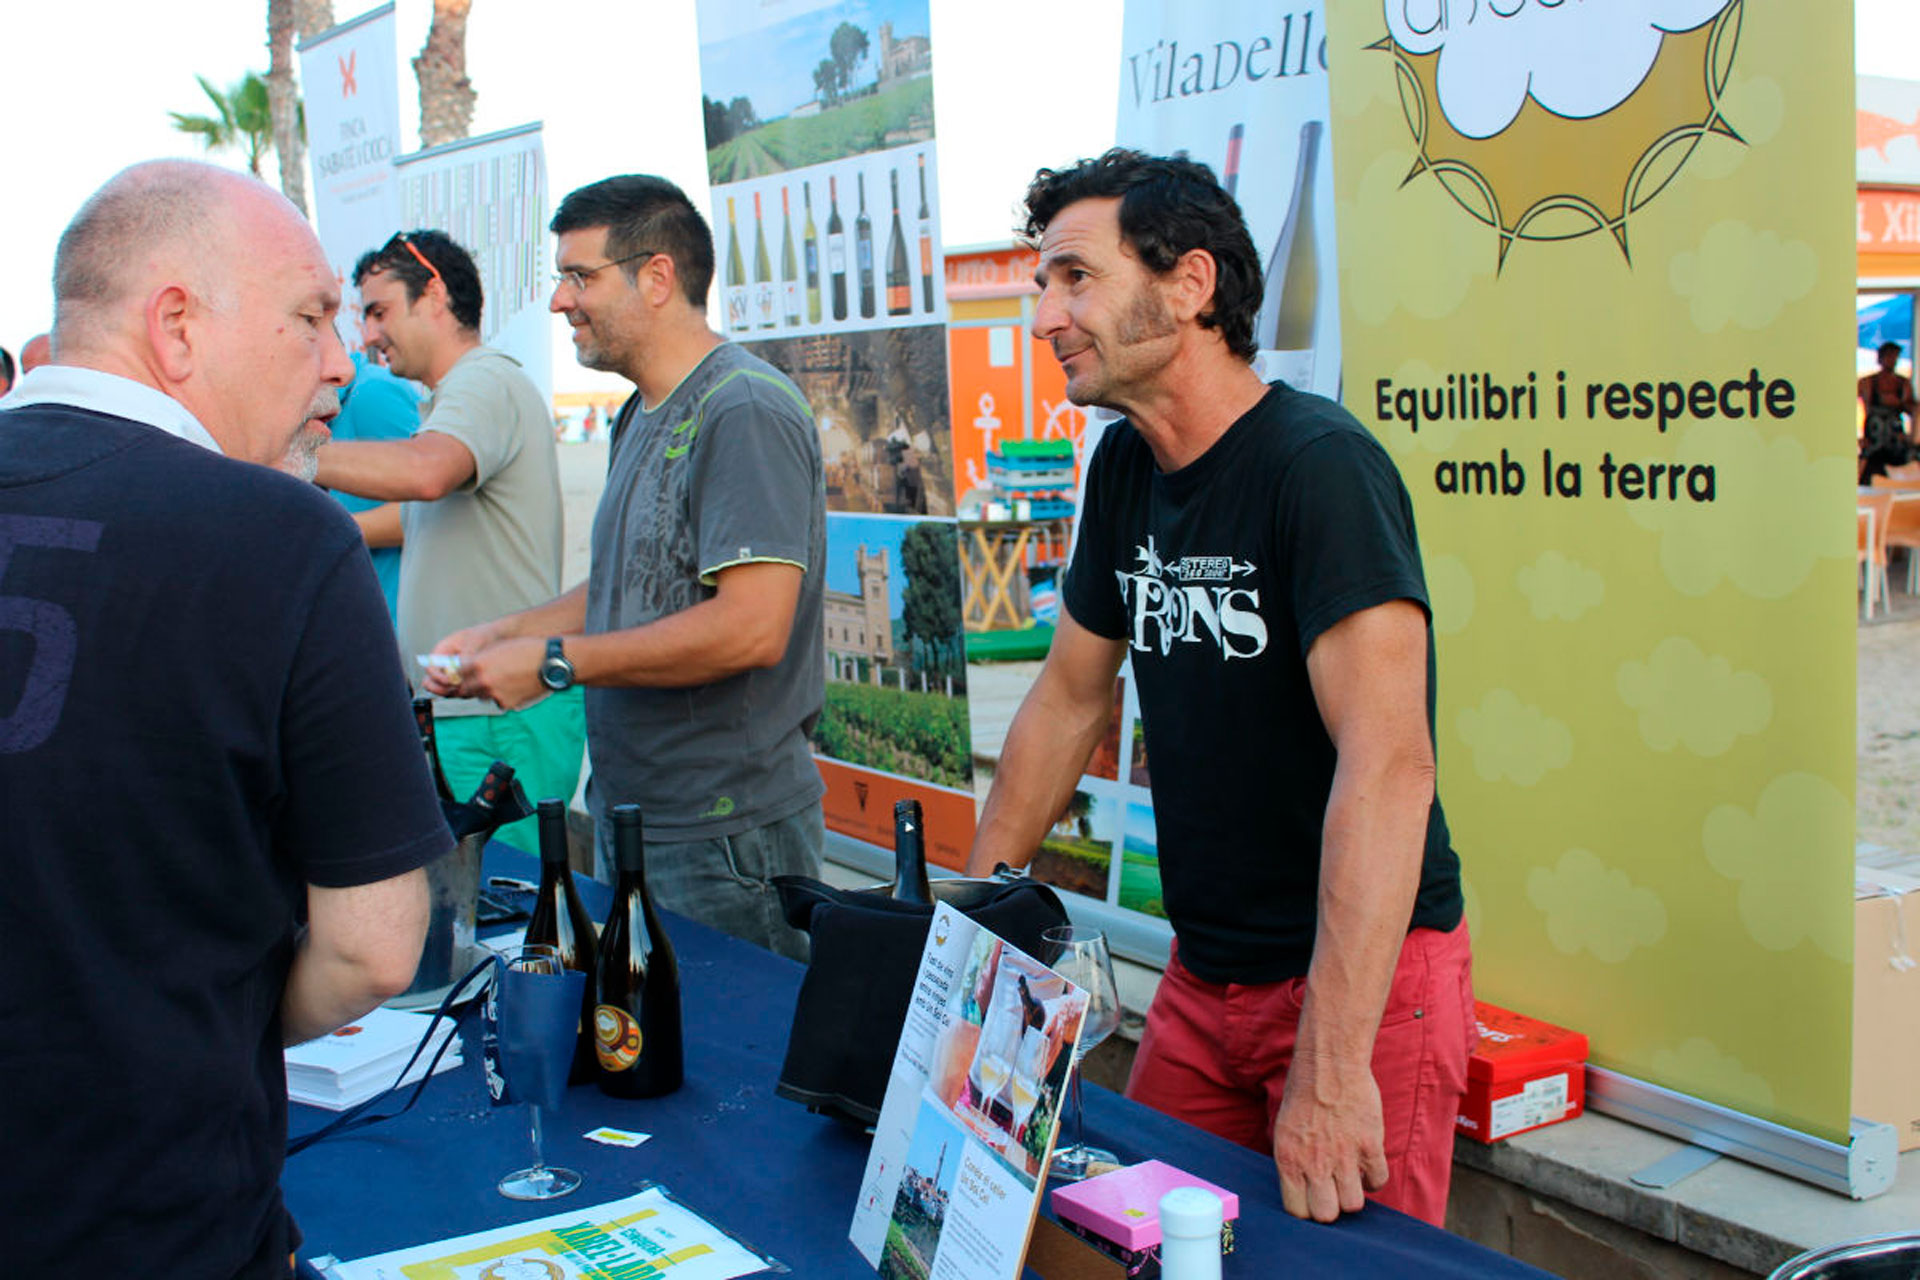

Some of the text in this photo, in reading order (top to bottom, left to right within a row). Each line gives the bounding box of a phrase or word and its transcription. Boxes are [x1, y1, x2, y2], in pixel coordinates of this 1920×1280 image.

[1376, 367, 1796, 433] Equilibri i respecte
[1435, 448, 1716, 502] amb la terra
[1181, 559, 1228, 569] STEREO
